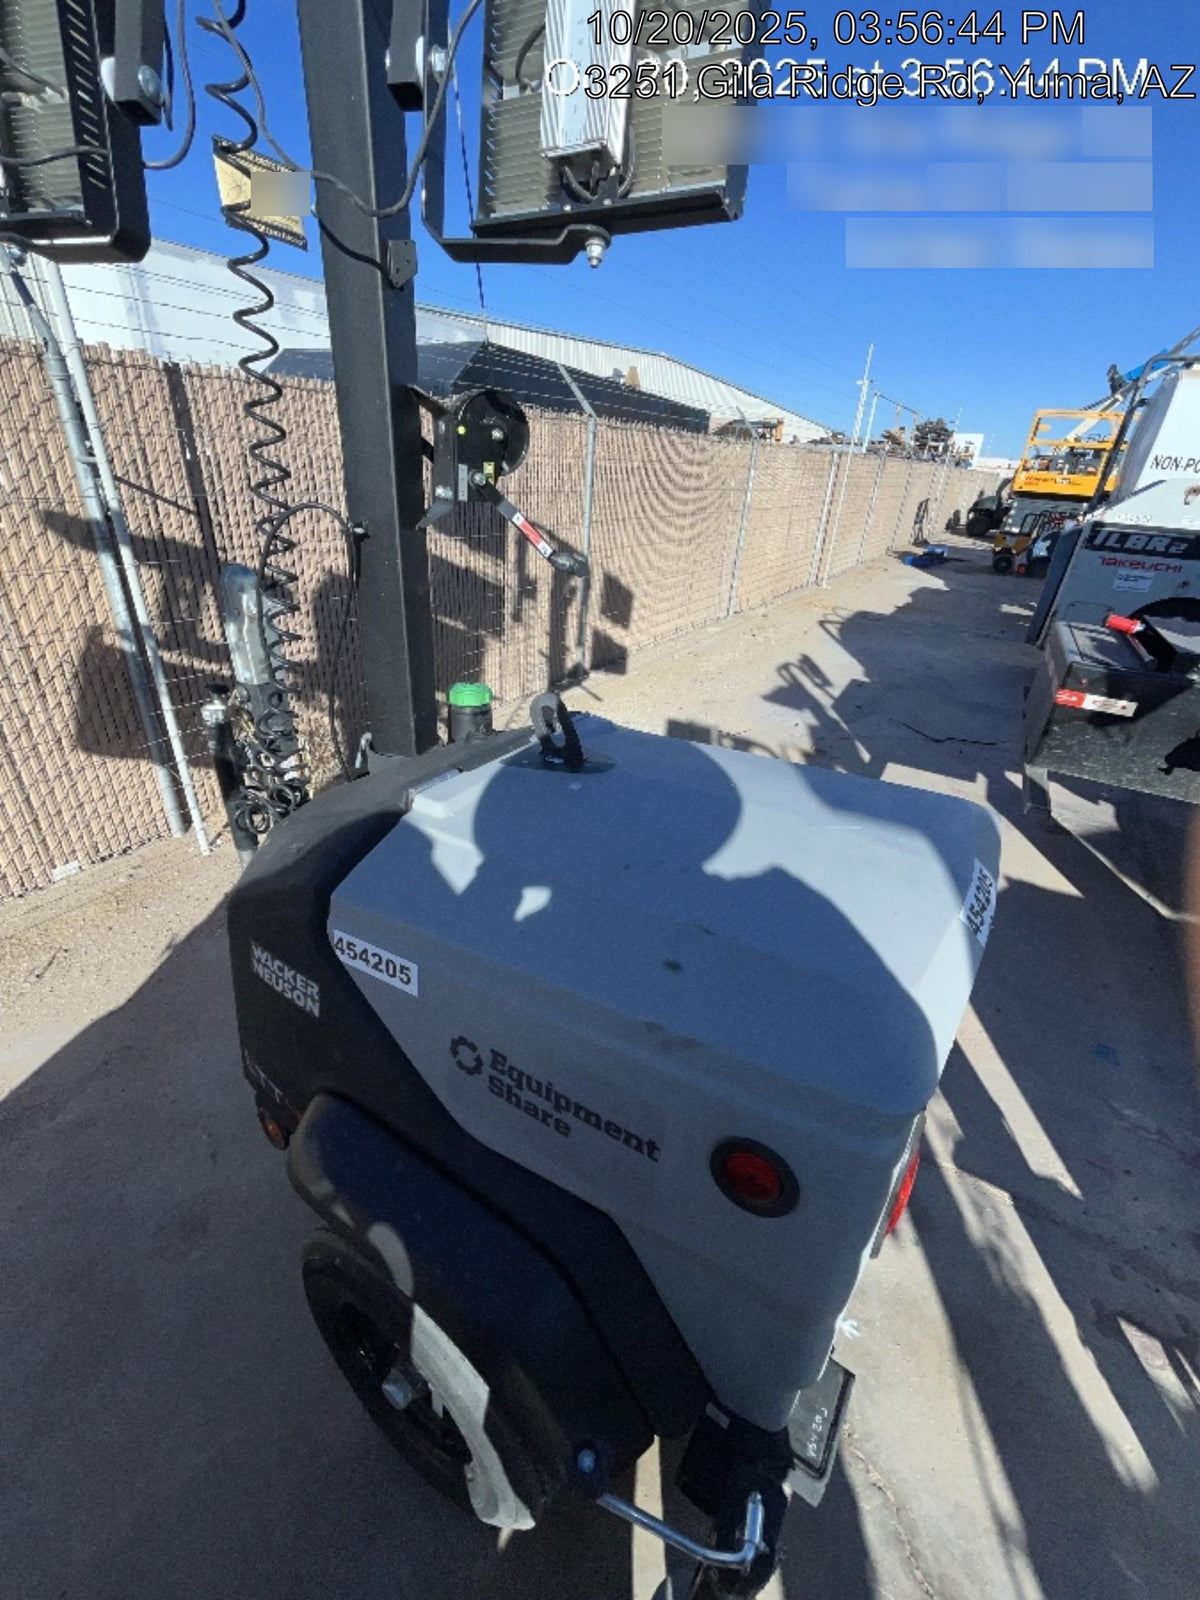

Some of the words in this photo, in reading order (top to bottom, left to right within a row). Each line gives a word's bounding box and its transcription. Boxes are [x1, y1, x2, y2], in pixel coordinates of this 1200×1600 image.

[252, 943, 320, 999] WACKER
[253, 959, 321, 1018] NEUSON
[334, 936, 412, 986] 454205
[487, 1074, 571, 1138] Share
[489, 1048, 661, 1163] Equipment
